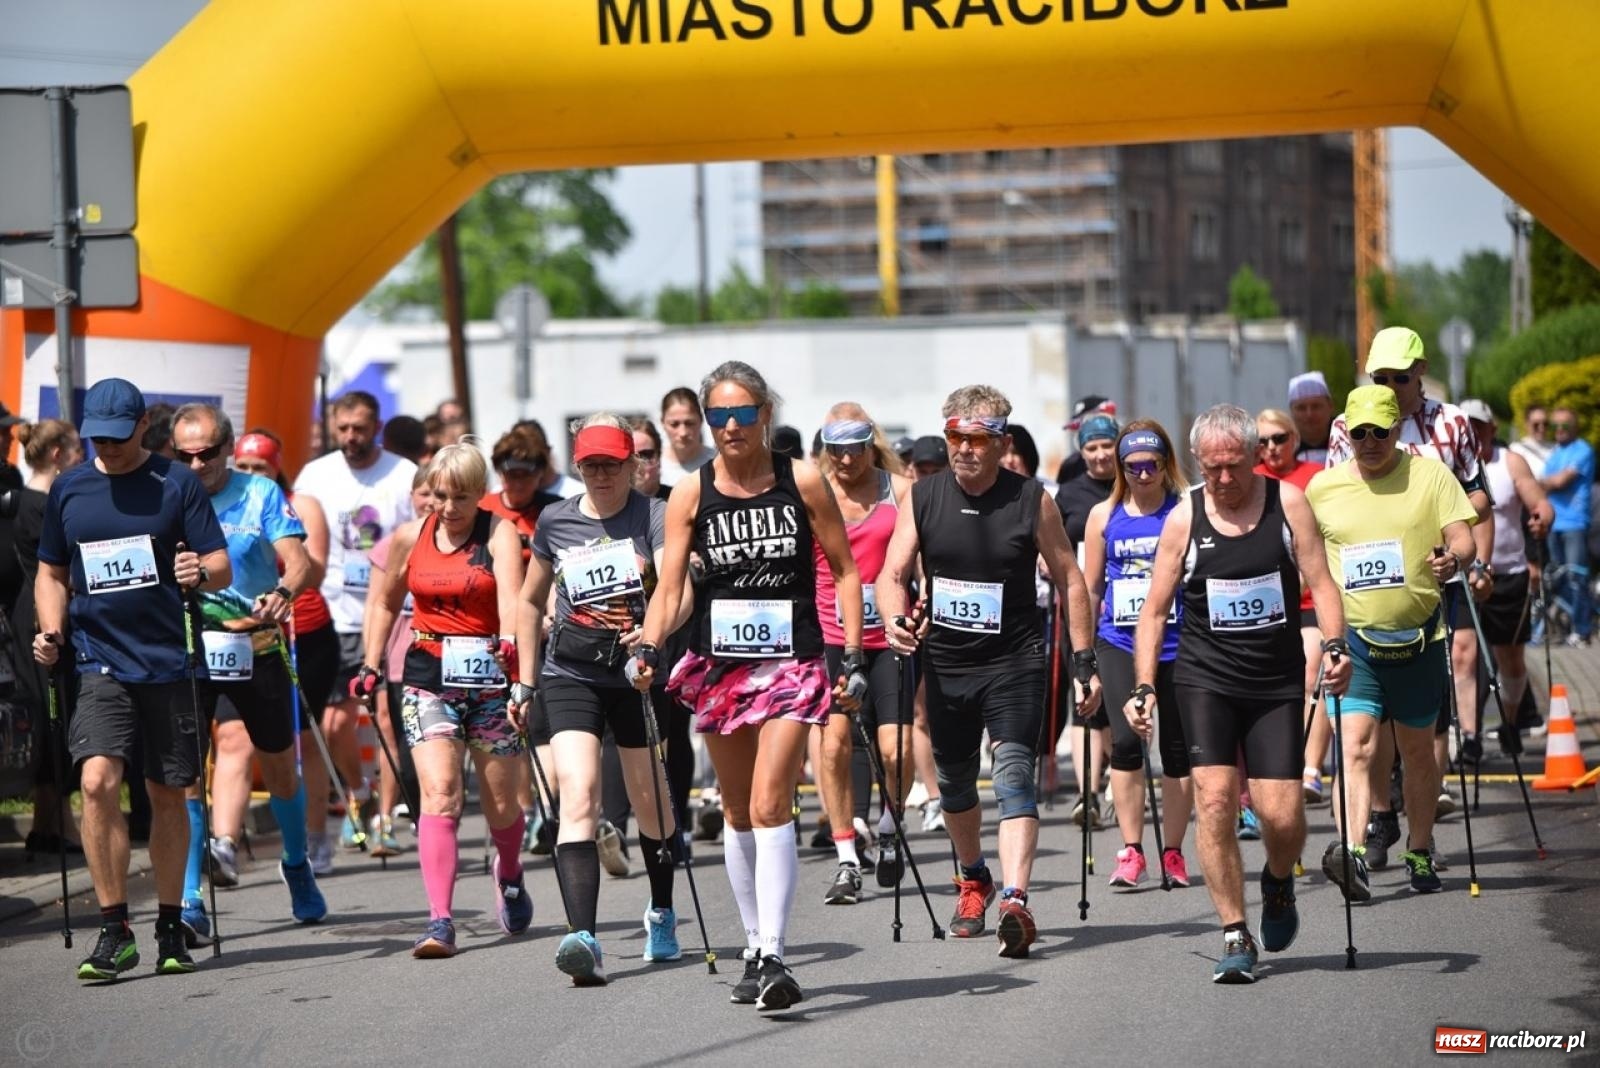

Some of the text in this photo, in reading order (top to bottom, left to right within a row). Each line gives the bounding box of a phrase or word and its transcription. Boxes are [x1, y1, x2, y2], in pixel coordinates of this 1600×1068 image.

[706, 505, 798, 546] ANGELS
[707, 537, 797, 566] NEVER
[103, 559, 135, 577] 114
[586, 565, 617, 586] 112
[734, 562, 795, 588] alone
[1356, 560, 1386, 577] 129
[950, 600, 981, 619] 133
[1128, 597, 1146, 613] 12
[1228, 598, 1265, 618] 139
[732, 623, 771, 642] 108
[209, 652, 237, 668] 118
[463, 658, 491, 675] 121
